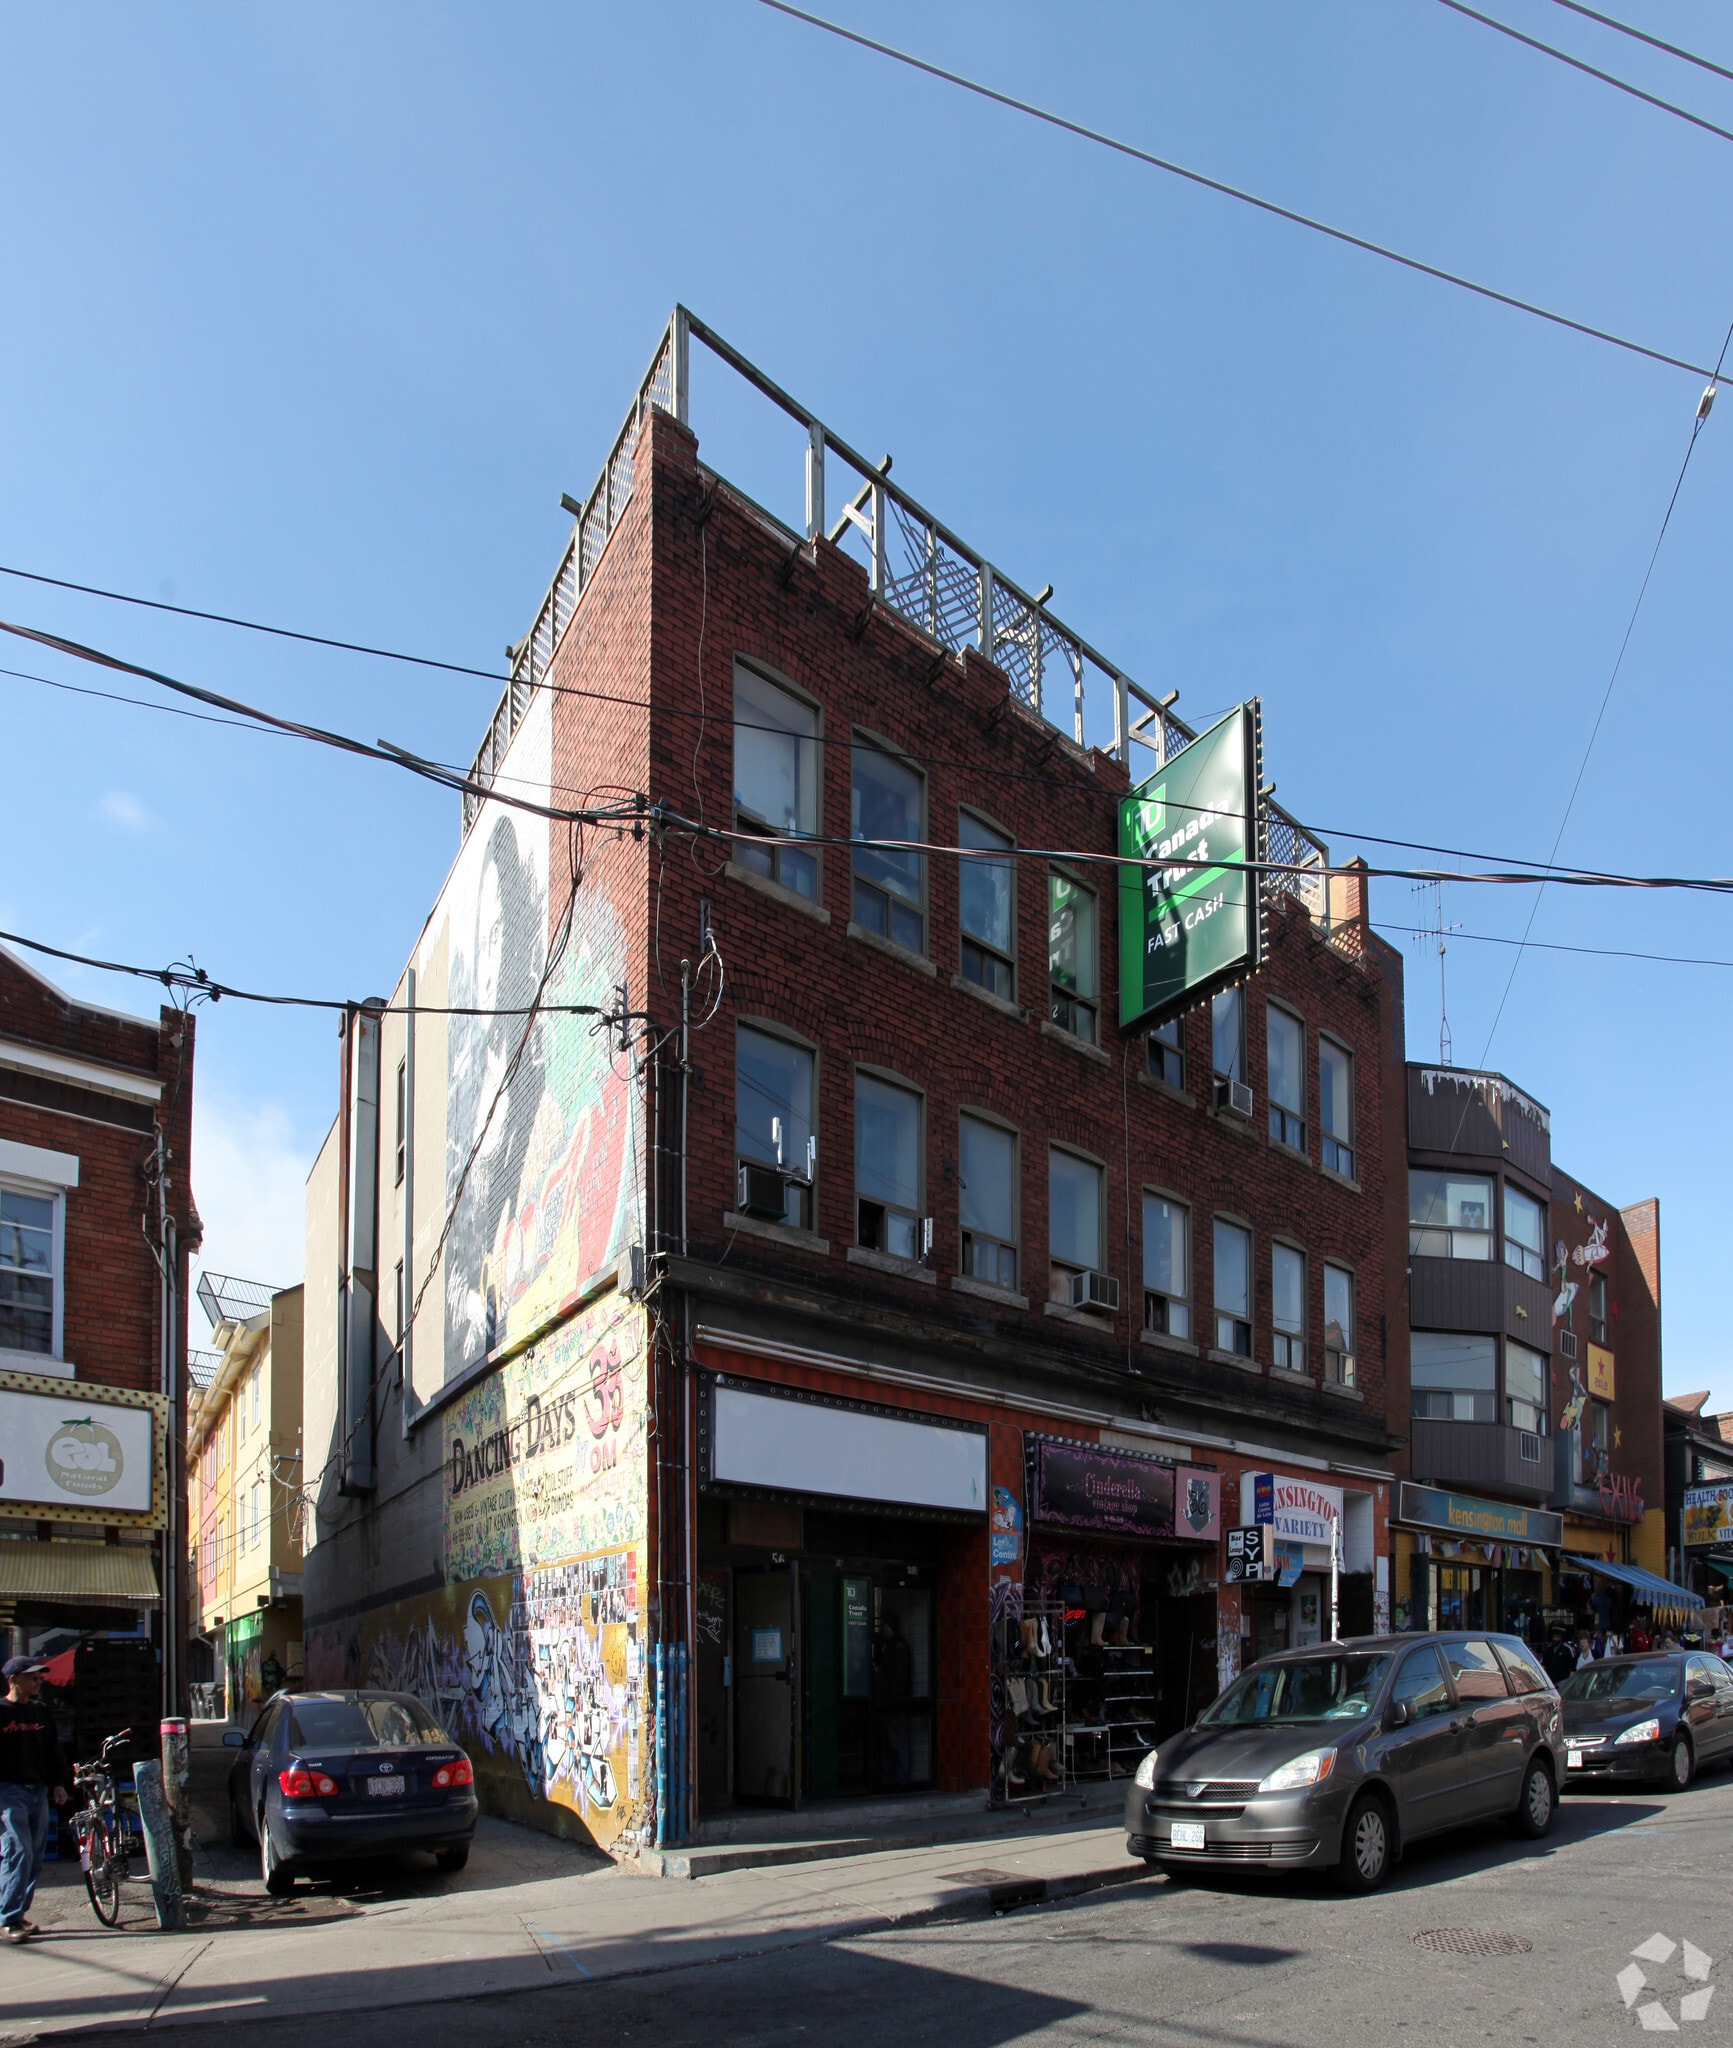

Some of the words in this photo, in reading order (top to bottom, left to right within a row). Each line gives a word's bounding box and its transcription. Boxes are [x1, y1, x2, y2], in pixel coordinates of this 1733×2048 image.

[1135, 797, 1162, 836] TD
[1146, 799, 1229, 868] Canada
[1147, 838, 1209, 897] Trust
[1147, 921, 1181, 954] FAST
[1184, 892, 1223, 930] CASH
[452, 1423, 521, 1495] DANCING
[526, 1390, 576, 1459] DAYS
[590, 1439, 617, 1474] OM
[61, 1471, 108, 1482] Natural
[65, 1480, 103, 1490] Foods
[1085, 1472, 1142, 1501] Cinderella
[551, 1490, 574, 1516] DUNDAS
[1092, 1499, 1119, 1513] vintage
[1121, 1502, 1138, 1517] shop
[1686, 1489, 1716, 1505] HEALTH
[1718, 1487, 1733, 1501] FOO
[1275, 1516, 1326, 1538] VARIETY
[1448, 1497, 1505, 1532] kensington
[1507, 1511, 1528, 1537] mall
[1687, 1528, 1716, 1542] BULK
[1719, 1525, 1733, 1539] VIT
[846, 1587, 856, 1597] TD
[848, 1604, 867, 1612] Canada
